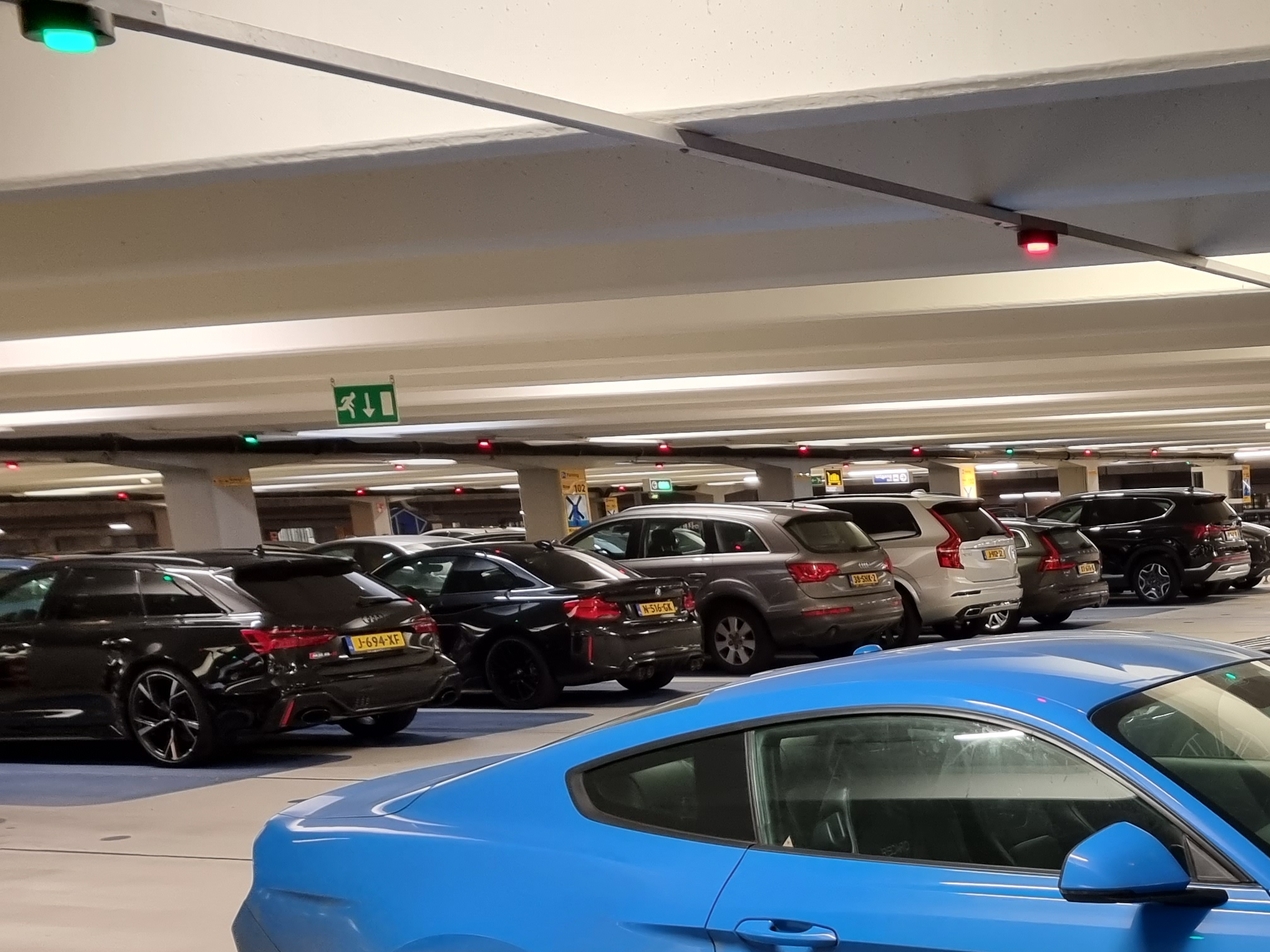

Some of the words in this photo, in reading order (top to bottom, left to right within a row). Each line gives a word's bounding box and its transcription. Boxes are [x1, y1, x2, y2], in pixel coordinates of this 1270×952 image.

[574, 483, 586, 493] 102
[642, 602, 674, 614] N-516-GK
[358, 633, 400, 649] J-694-XF
